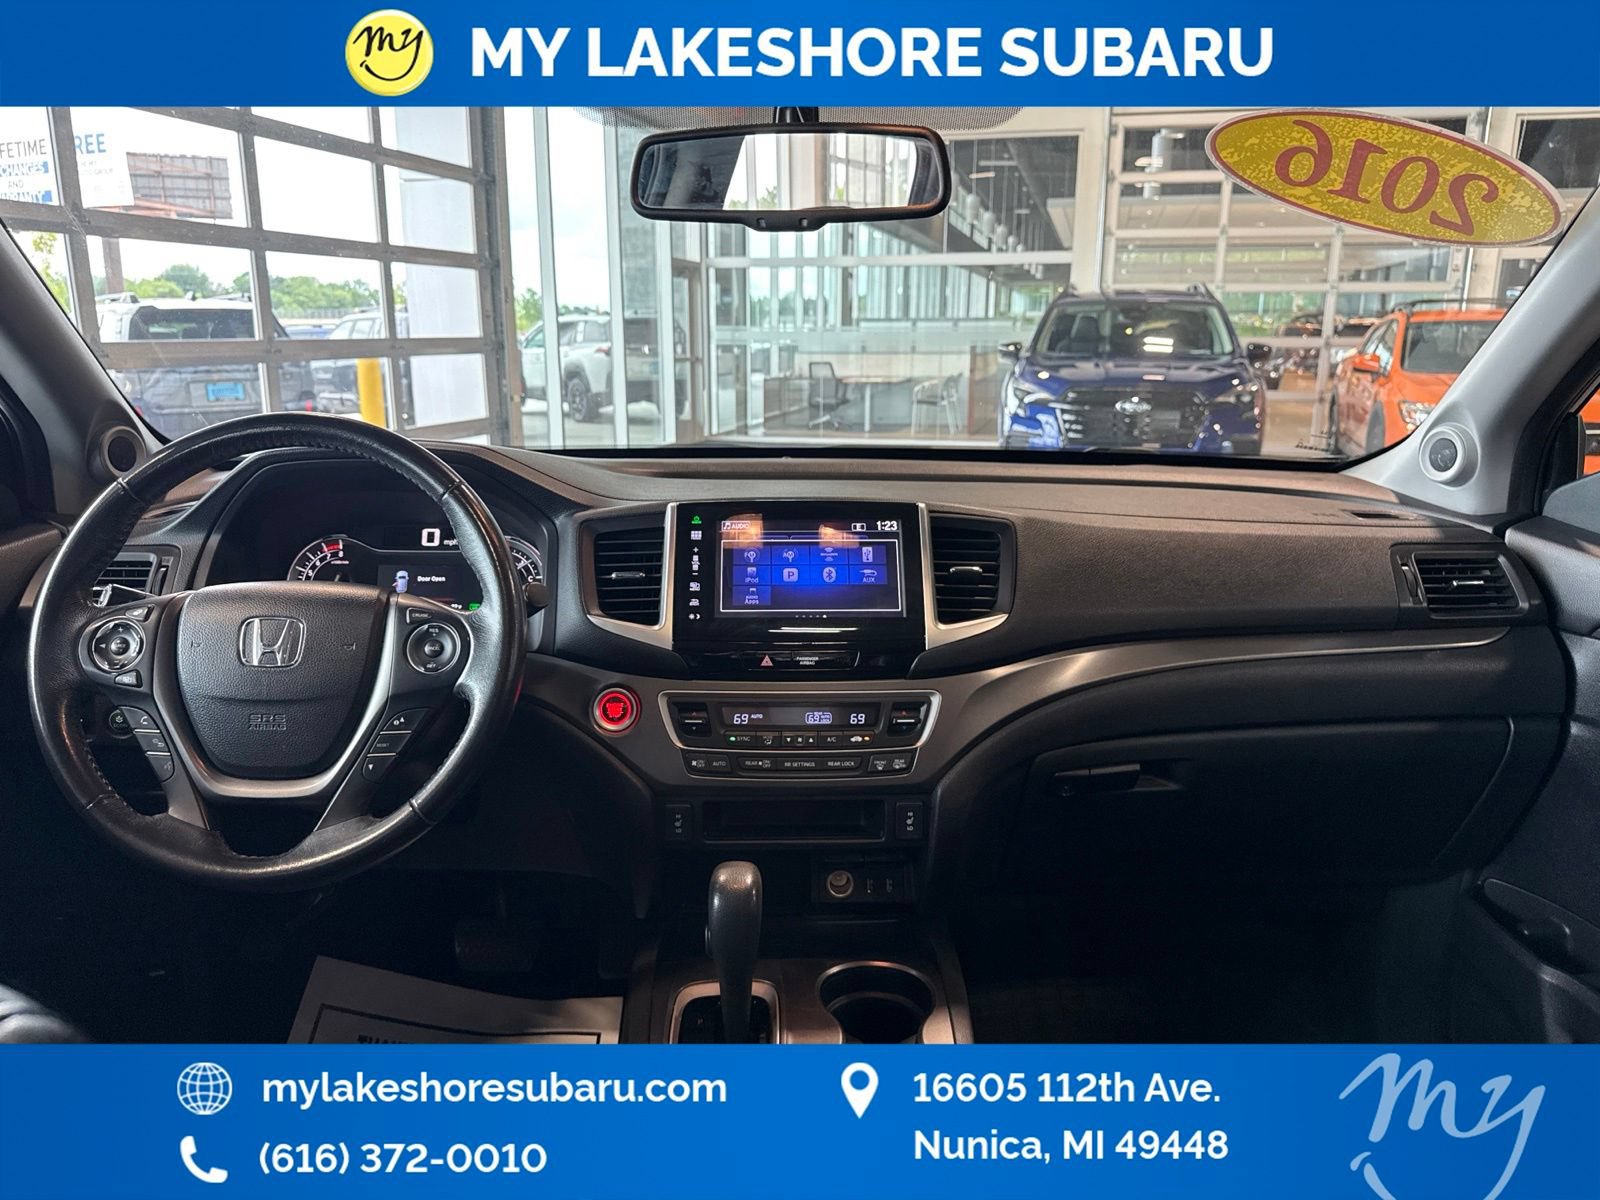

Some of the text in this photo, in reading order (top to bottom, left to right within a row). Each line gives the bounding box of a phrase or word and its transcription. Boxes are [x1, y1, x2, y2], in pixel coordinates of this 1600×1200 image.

[876, 520, 898, 530] 1:23
[249, 714, 286, 722] SRS
[733, 714, 749, 724] 69
[808, 714, 820, 723] 69
[850, 714, 865, 724] 69
